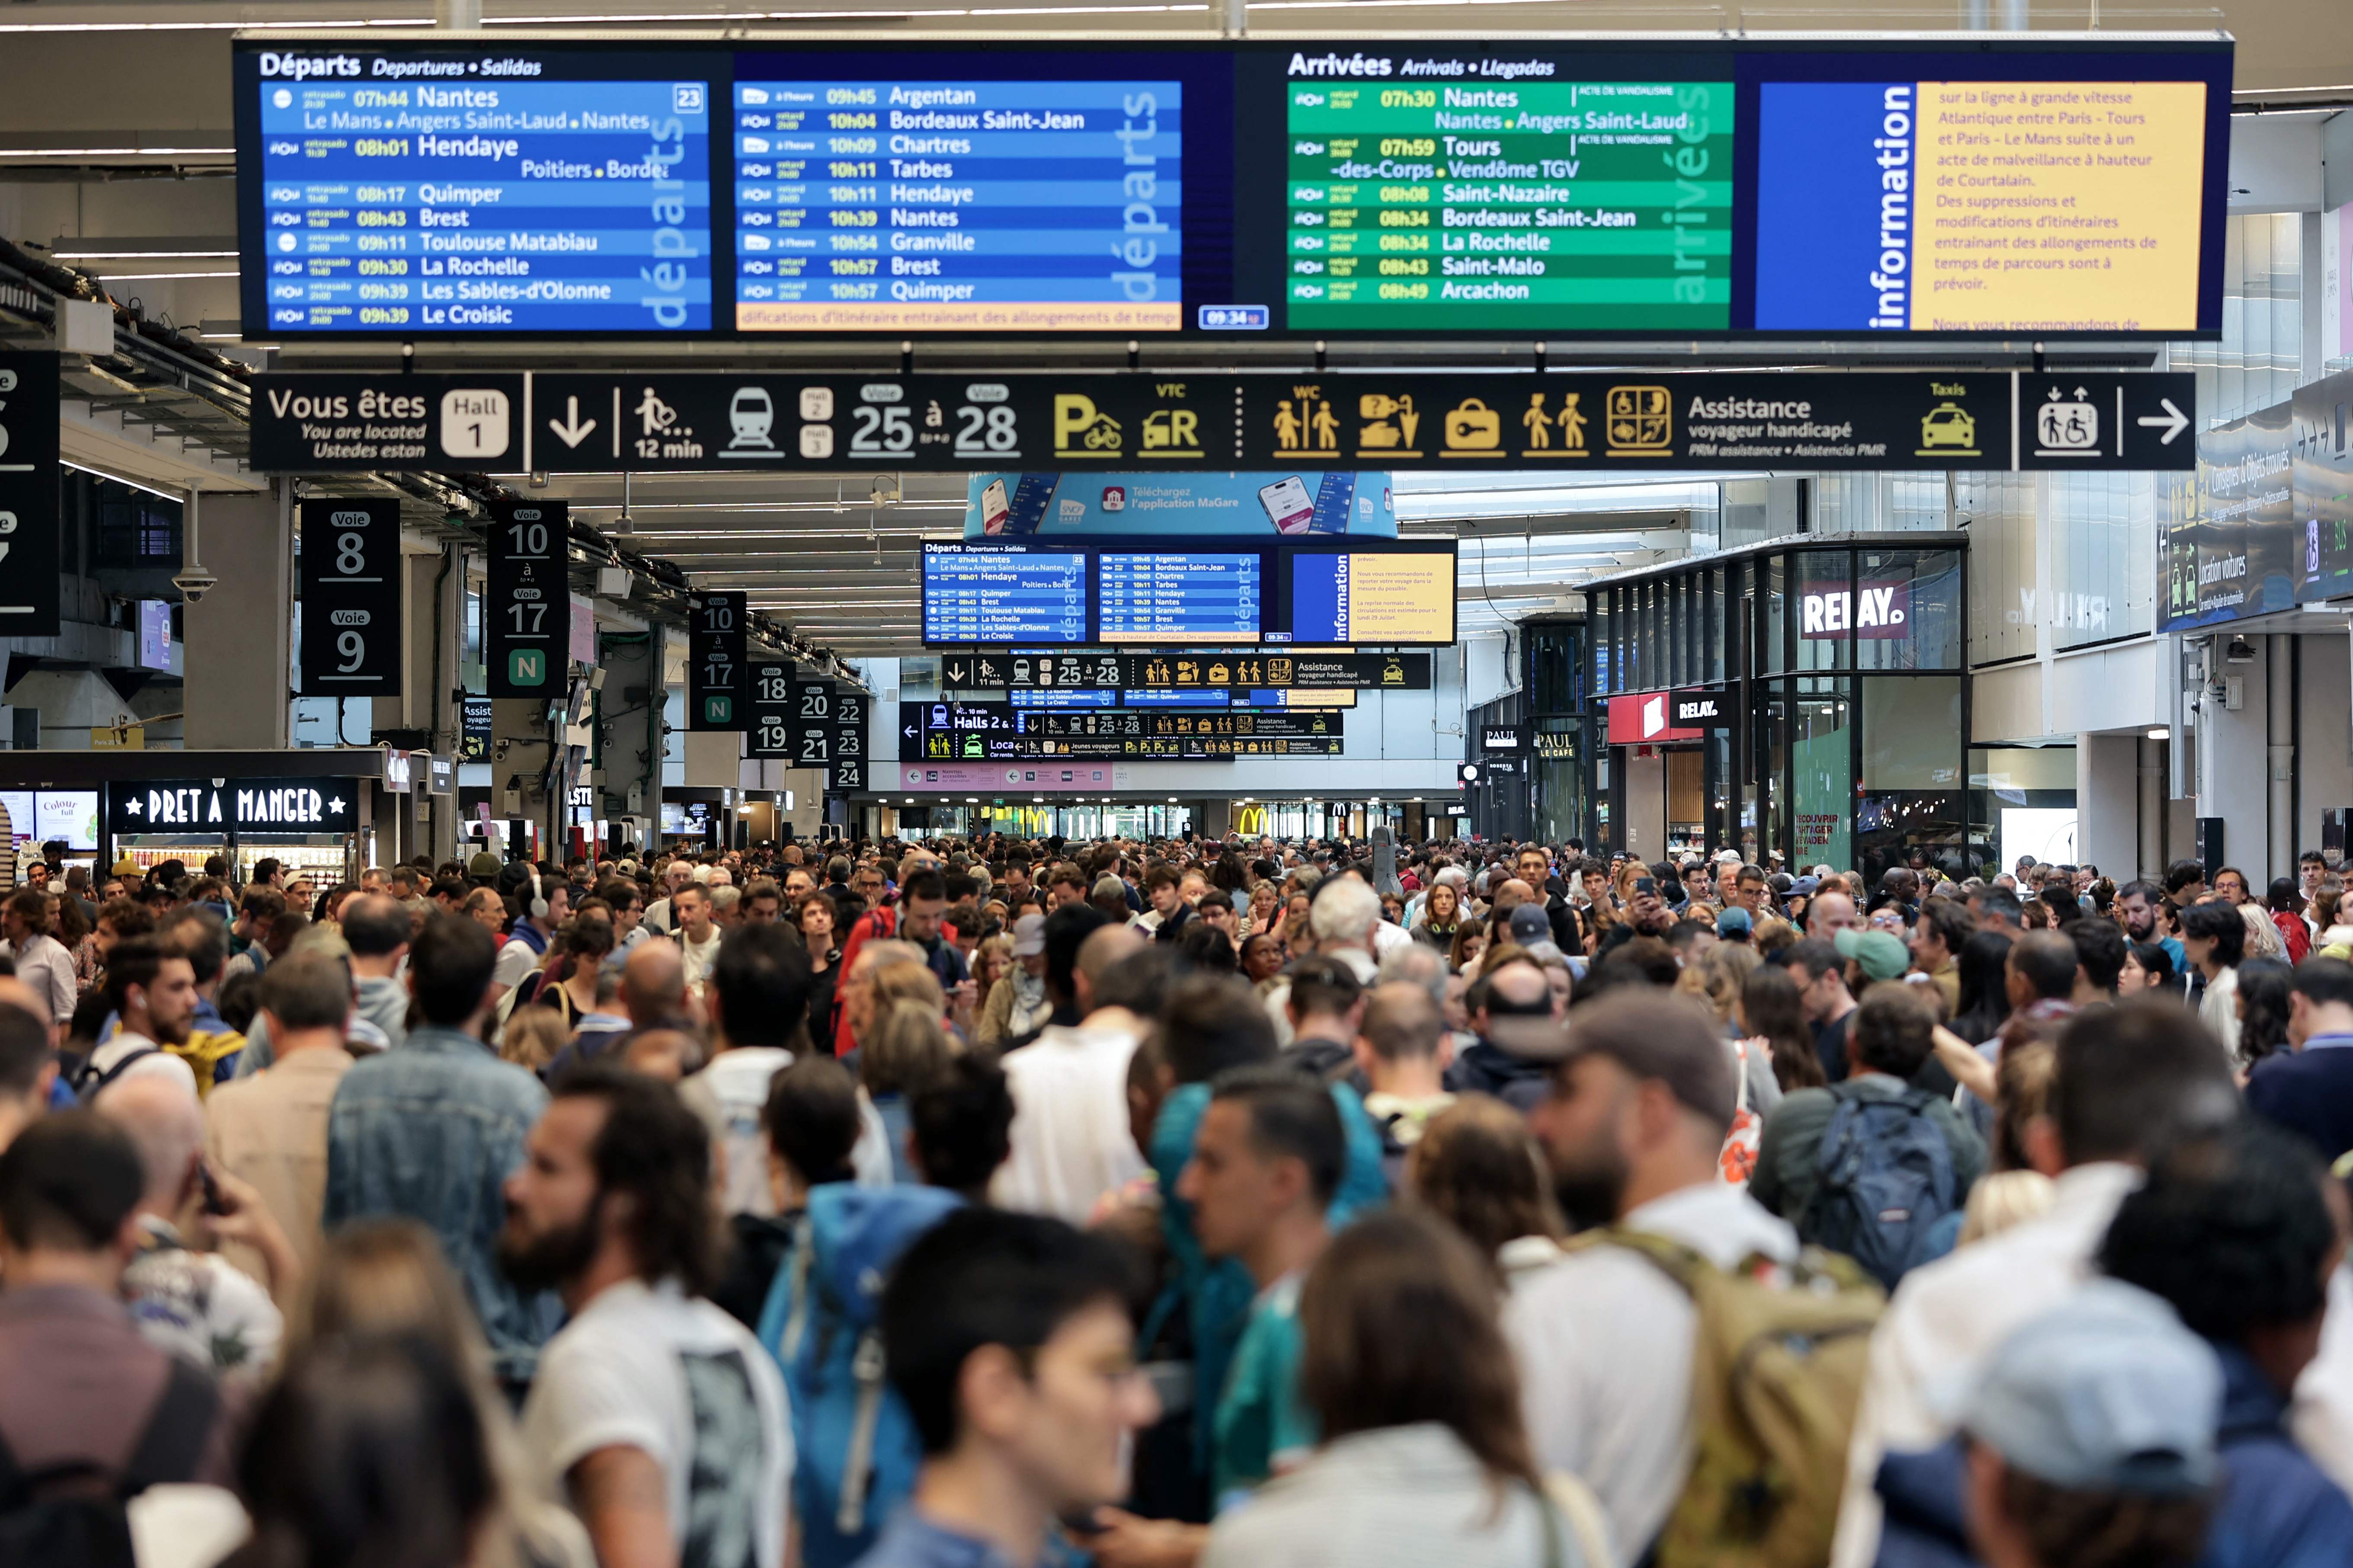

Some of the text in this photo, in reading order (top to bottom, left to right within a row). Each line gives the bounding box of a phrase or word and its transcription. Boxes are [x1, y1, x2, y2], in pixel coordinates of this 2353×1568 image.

[260, 52, 542, 83] Départs Departures Salidas
[1287, 52, 1555, 80] Arrivées Arrivals Llegadas
[353, 86, 499, 108] 07h44 Nantes
[677, 89, 701, 107] 23
[826, 86, 976, 109] 09h45 Argentan
[1380, 87, 1519, 108] 07h30 Nantes
[304, 111, 650, 134] Le Mans Angers Saint-Laud Nantes
[827, 110, 1085, 129] 10h04 Bordeaux Saint-Jean
[354, 135, 519, 162] 08h01 Hendaye
[1380, 136, 1501, 157] 07h59 Tours
[1937, 153, 2153, 166] acte de malveillance à hauteur
[1936, 173, 2035, 187] de Courtalain.
[1379, 183, 1570, 203] 08h08 Saint-Nazaire
[1661, 86, 1711, 304] arrivées
[1869, 86, 1911, 329] information
[640, 117, 699, 329] départs
[357, 232, 598, 251] 09h11 Toulouse Matabiau
[358, 256, 529, 275] 09h30 La Rochelle
[1378, 256, 1545, 275] 08h43 Saint-Malo
[359, 280, 611, 300] 09h39 Les Sables-d'Olonne
[1378, 281, 1529, 300] 08h49 Arcachon
[359, 306, 513, 324] 09h39 Le Croisic
[1156, 384, 1186, 398] VTC
[1293, 385, 1320, 399] WC
[1930, 382, 1966, 396] Taxis
[268, 389, 426, 419] Vous êtes
[454, 397, 497, 415] Hall
[1688, 396, 1811, 419] Assistance
[301, 423, 427, 440] You are located
[468, 423, 481, 448] 1
[848, 400, 1021, 454] 25 à 28
[1688, 421, 1853, 442] voyageur handicapé
[635, 438, 703, 458] 12 min
[2212, 443, 2289, 496] Consignes & Objets trouvés
[1132, 486, 1191, 499] Téléchargez
[1132, 498, 1239, 510] l'application MaGare
[333, 513, 365, 526] Voie
[517, 510, 538, 519] Voie
[507, 524, 548, 554] 10
[2334, 518, 2347, 551] BUS
[336, 532, 365, 574] 8
[925, 544, 962, 555] Départs
[965, 545, 999, 554] Departures
[523, 563, 531, 576] à
[2199, 551, 2246, 585] Location voitures
[516, 589, 537, 598] Voie
[1334, 555, 1347, 641] information
[335, 612, 365, 623] Voie
[507, 603, 548, 632] 17
[704, 608, 732, 629] 10
[337, 630, 365, 673] 9
[518, 657, 536, 678] N
[704, 664, 733, 685] 17
[1058, 664, 1119, 683] 25 à 28
[1298, 662, 1343, 671] Assistance
[757, 678, 786, 699] 18
[712, 702, 725, 717] N
[801, 695, 827, 715] 20
[838, 705, 859, 721] 22
[954, 716, 1009, 729] Halls 2 &
[757, 726, 786, 748] 19
[838, 737, 859, 752] 23
[1487, 731, 1517, 739] PAUL
[1537, 734, 1574, 748] PAUL
[802, 739, 827, 758] 21
[1553, 748, 1574, 757] CAFÉ
[838, 768, 859, 784] 24
[43, 800, 76, 812] Colour
[149, 788, 322, 822] PRET A MANGER
